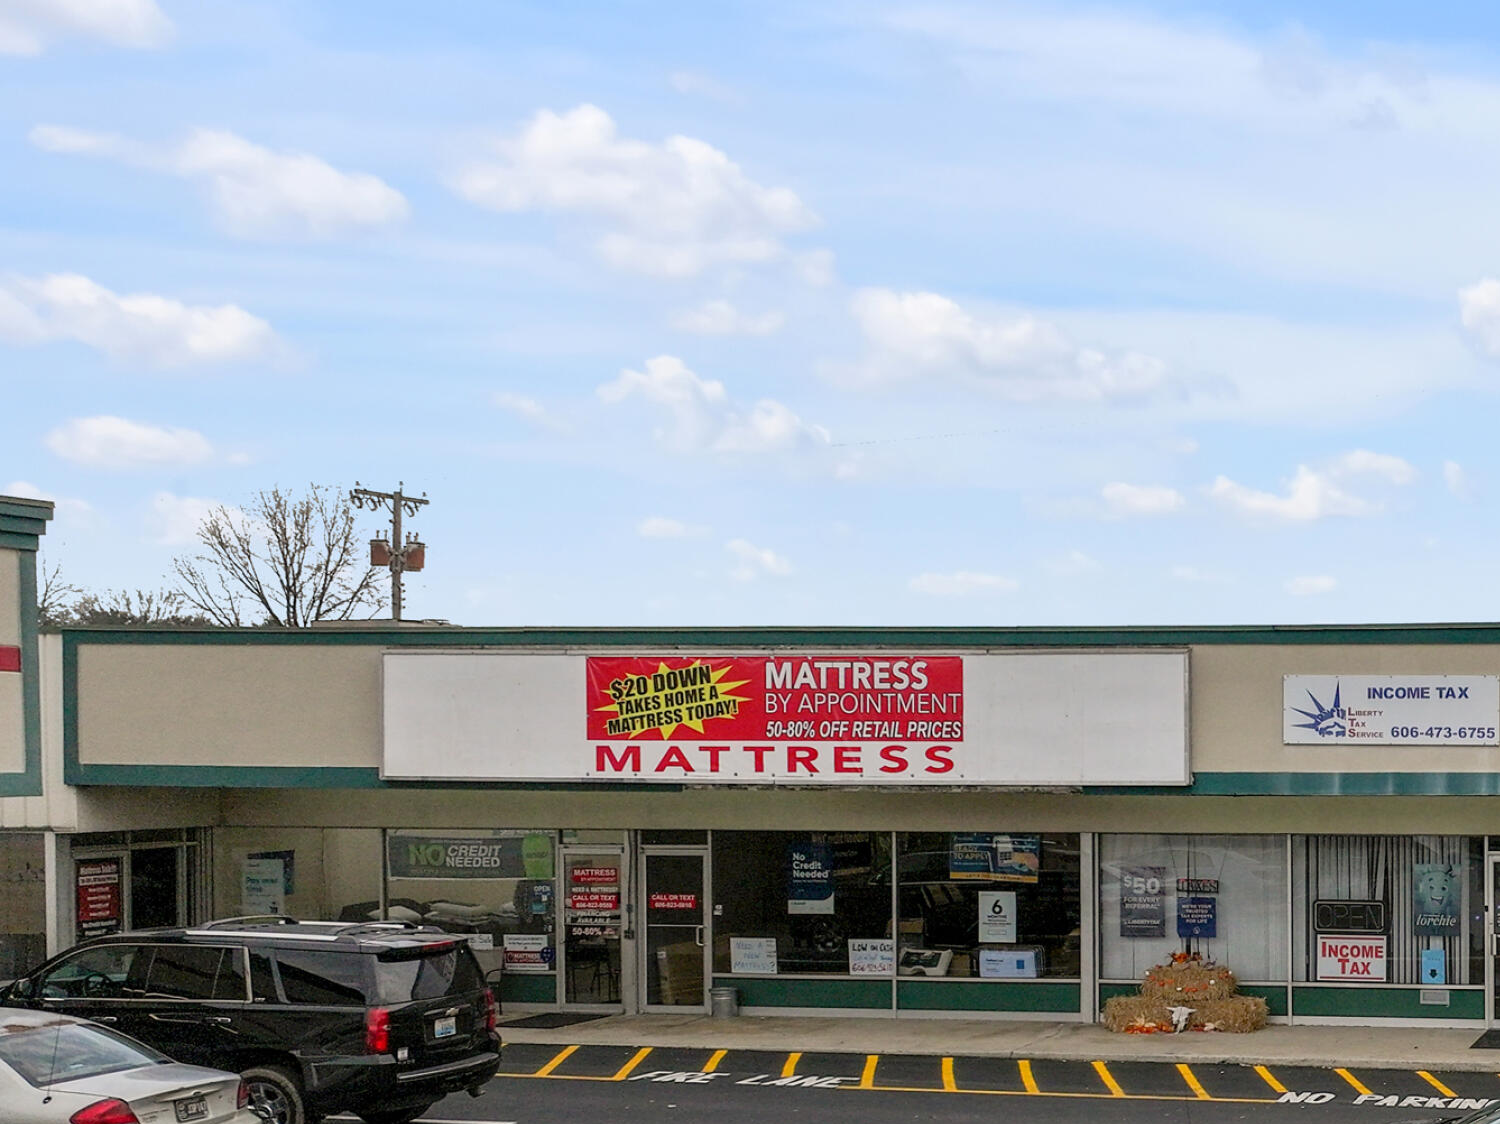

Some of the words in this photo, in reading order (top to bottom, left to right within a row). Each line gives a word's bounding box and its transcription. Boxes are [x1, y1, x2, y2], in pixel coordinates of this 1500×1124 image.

[610, 676, 648, 699] $20
[652, 664, 711, 697] DOWN
[765, 661, 929, 690] MATTRESS
[616, 697, 662, 716] TAKES
[664, 691, 706, 707] HOME
[709, 685, 719, 700] A
[1367, 687, 1430, 700] INCOME
[1436, 687, 1469, 699] TAX
[765, 693, 792, 714] BY
[798, 693, 961, 715] APPOINTMENT
[607, 709, 684, 735] MATTRESS
[686, 699, 738, 721] TODAY!
[766, 720, 815, 738] 50-80%
[820, 720, 849, 738] OFF
[852, 721, 903, 738] RETAIL
[907, 721, 961, 738] PRICES
[1391, 726, 1496, 738] 606-473-6755
[595, 746, 955, 773] MATTRESS
[408, 844, 446, 867] NO
[447, 845, 502, 857] CREDIT
[792, 852, 806, 861] No
[445, 857, 500, 868] NEEDED
[792, 861, 822, 870] Credit
[792, 870, 829, 878] Needed
[1123, 875, 1160, 895] $50
[992, 899, 1003, 915] 6
[1318, 904, 1381, 929] OPEN
[851, 943, 868, 951] LOW
[1321, 941, 1384, 959] INCOME
[1337, 958, 1371, 975] TAX
[628, 1070, 731, 1084] FIRE
[735, 1074, 860, 1089] LANE
[1277, 1091, 1336, 1104] NO
